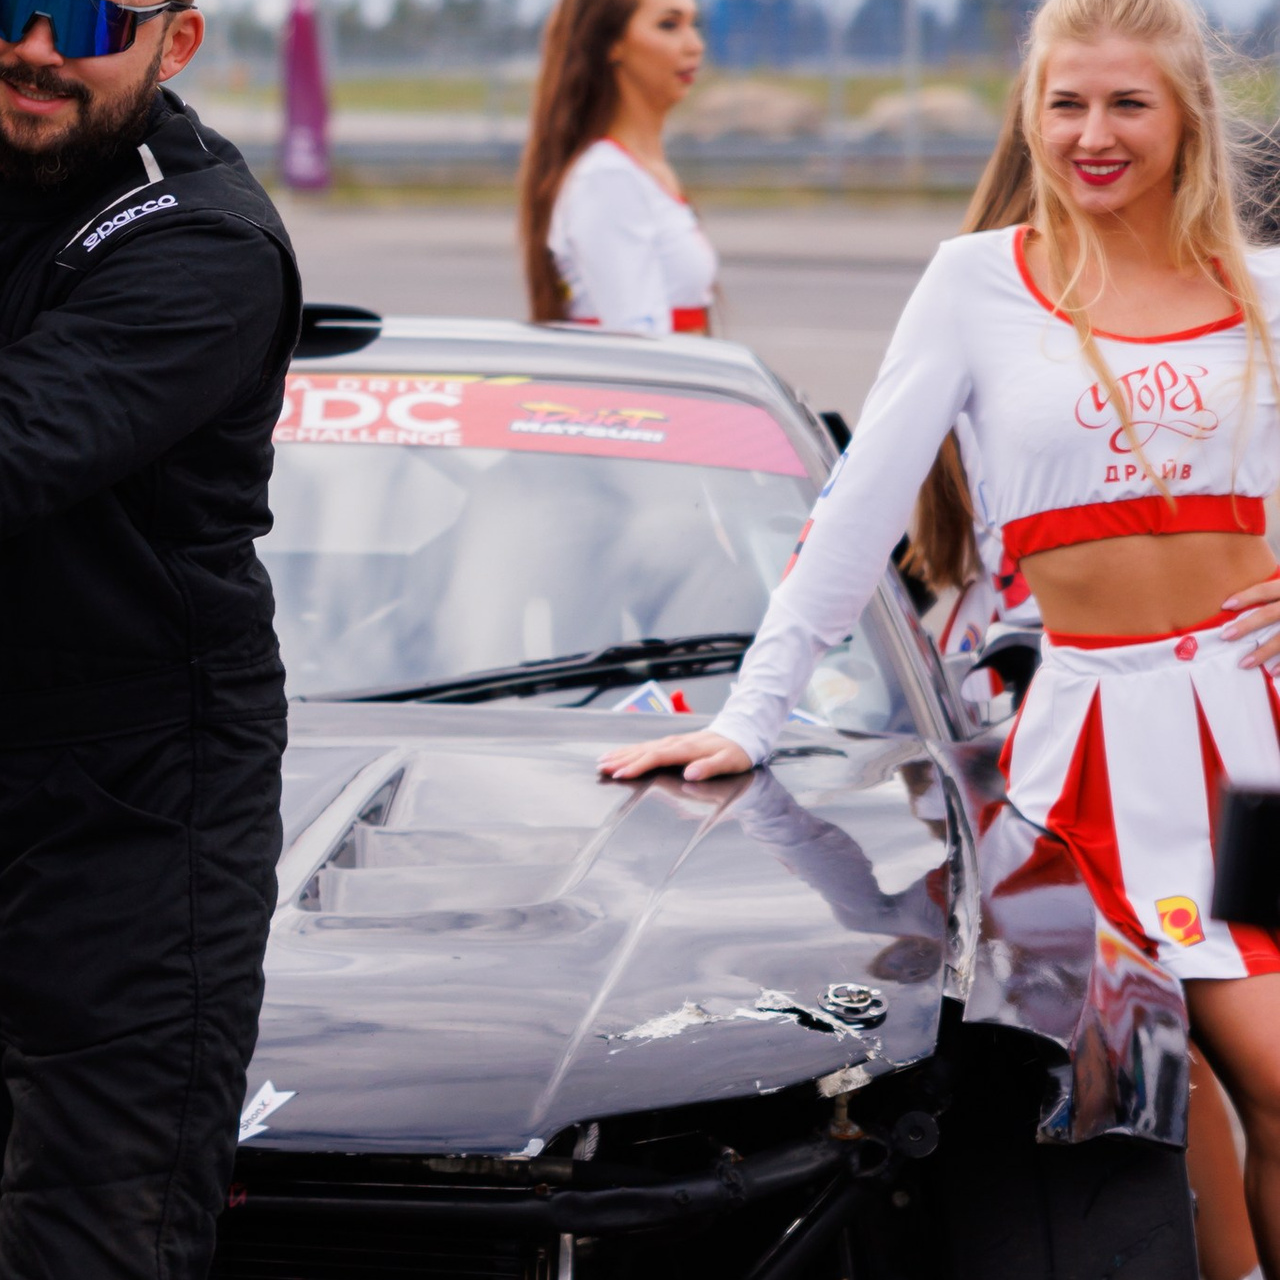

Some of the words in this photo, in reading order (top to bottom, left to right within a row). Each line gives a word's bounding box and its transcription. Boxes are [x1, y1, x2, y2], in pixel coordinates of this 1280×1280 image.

[83, 194, 179, 252] sparco
[274, 426, 463, 446] CHALLENGE
[1104, 458, 1193, 483] ДРЙВ
